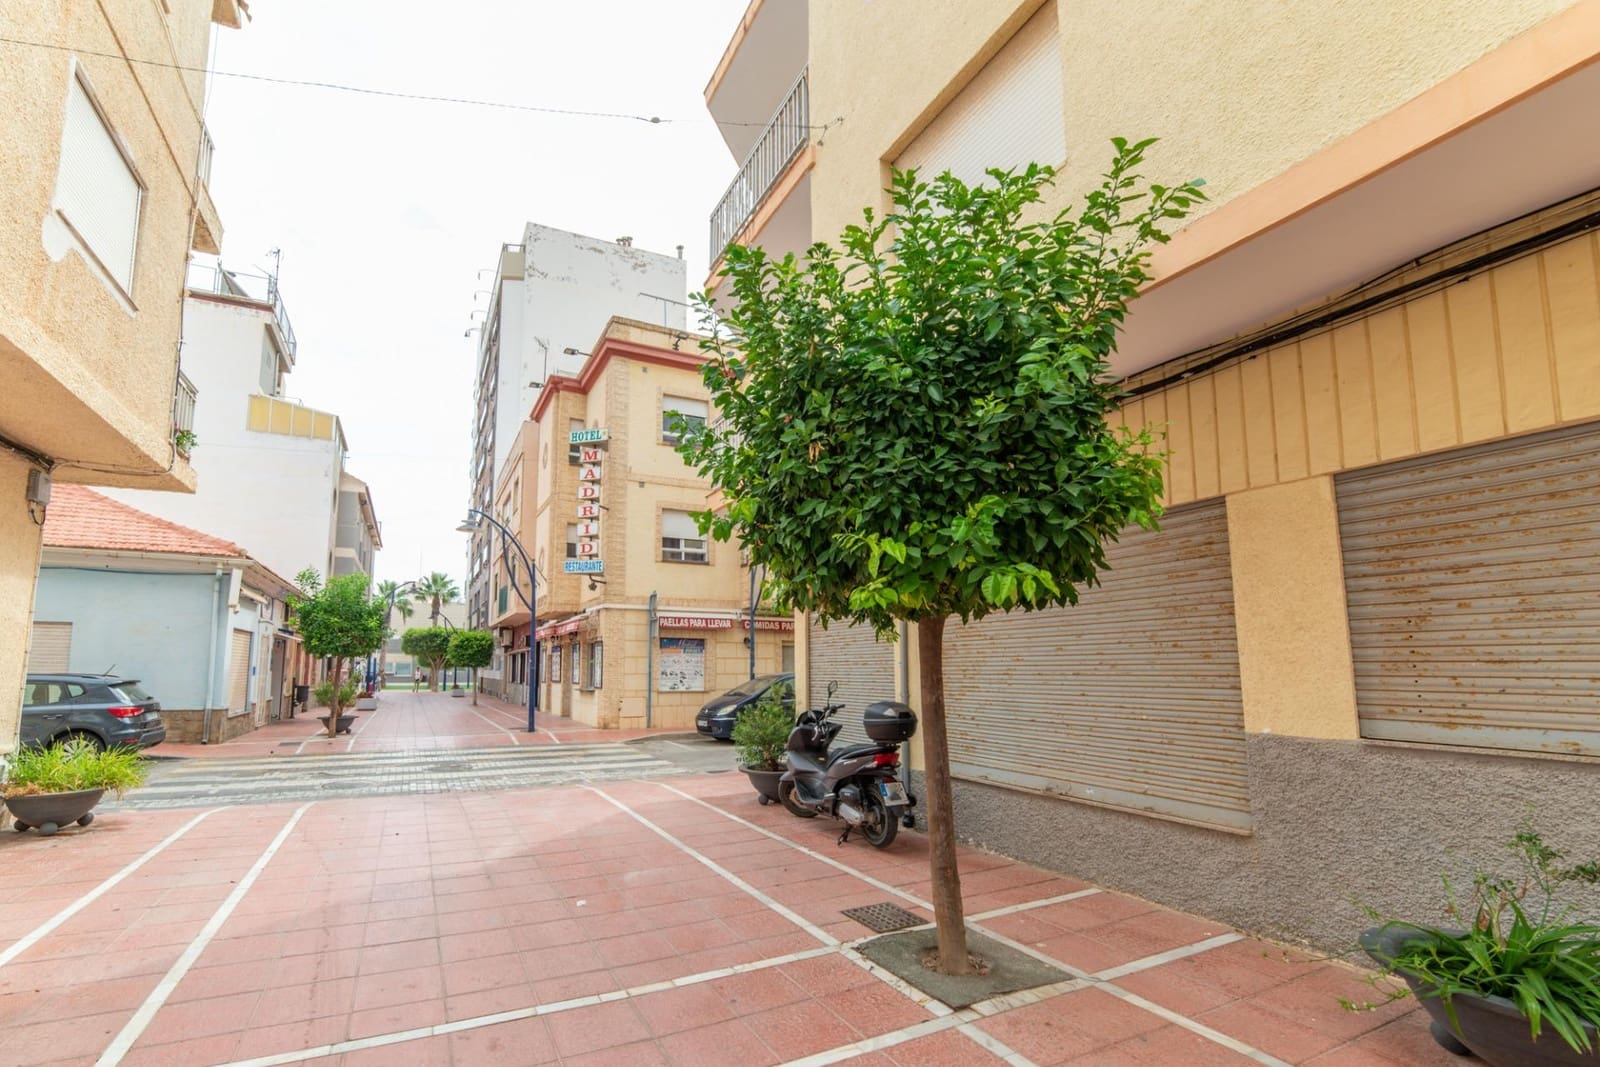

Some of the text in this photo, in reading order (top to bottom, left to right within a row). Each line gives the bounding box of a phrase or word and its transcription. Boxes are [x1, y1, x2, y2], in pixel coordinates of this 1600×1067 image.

[571, 429, 602, 442] HOTEL
[579, 450, 599, 555] MADRID
[564, 560, 603, 572] RESTAURANTE
[659, 618, 731, 628] PAELLAS PARA LLEVAR
[744, 620, 779, 630] CMIDAS
